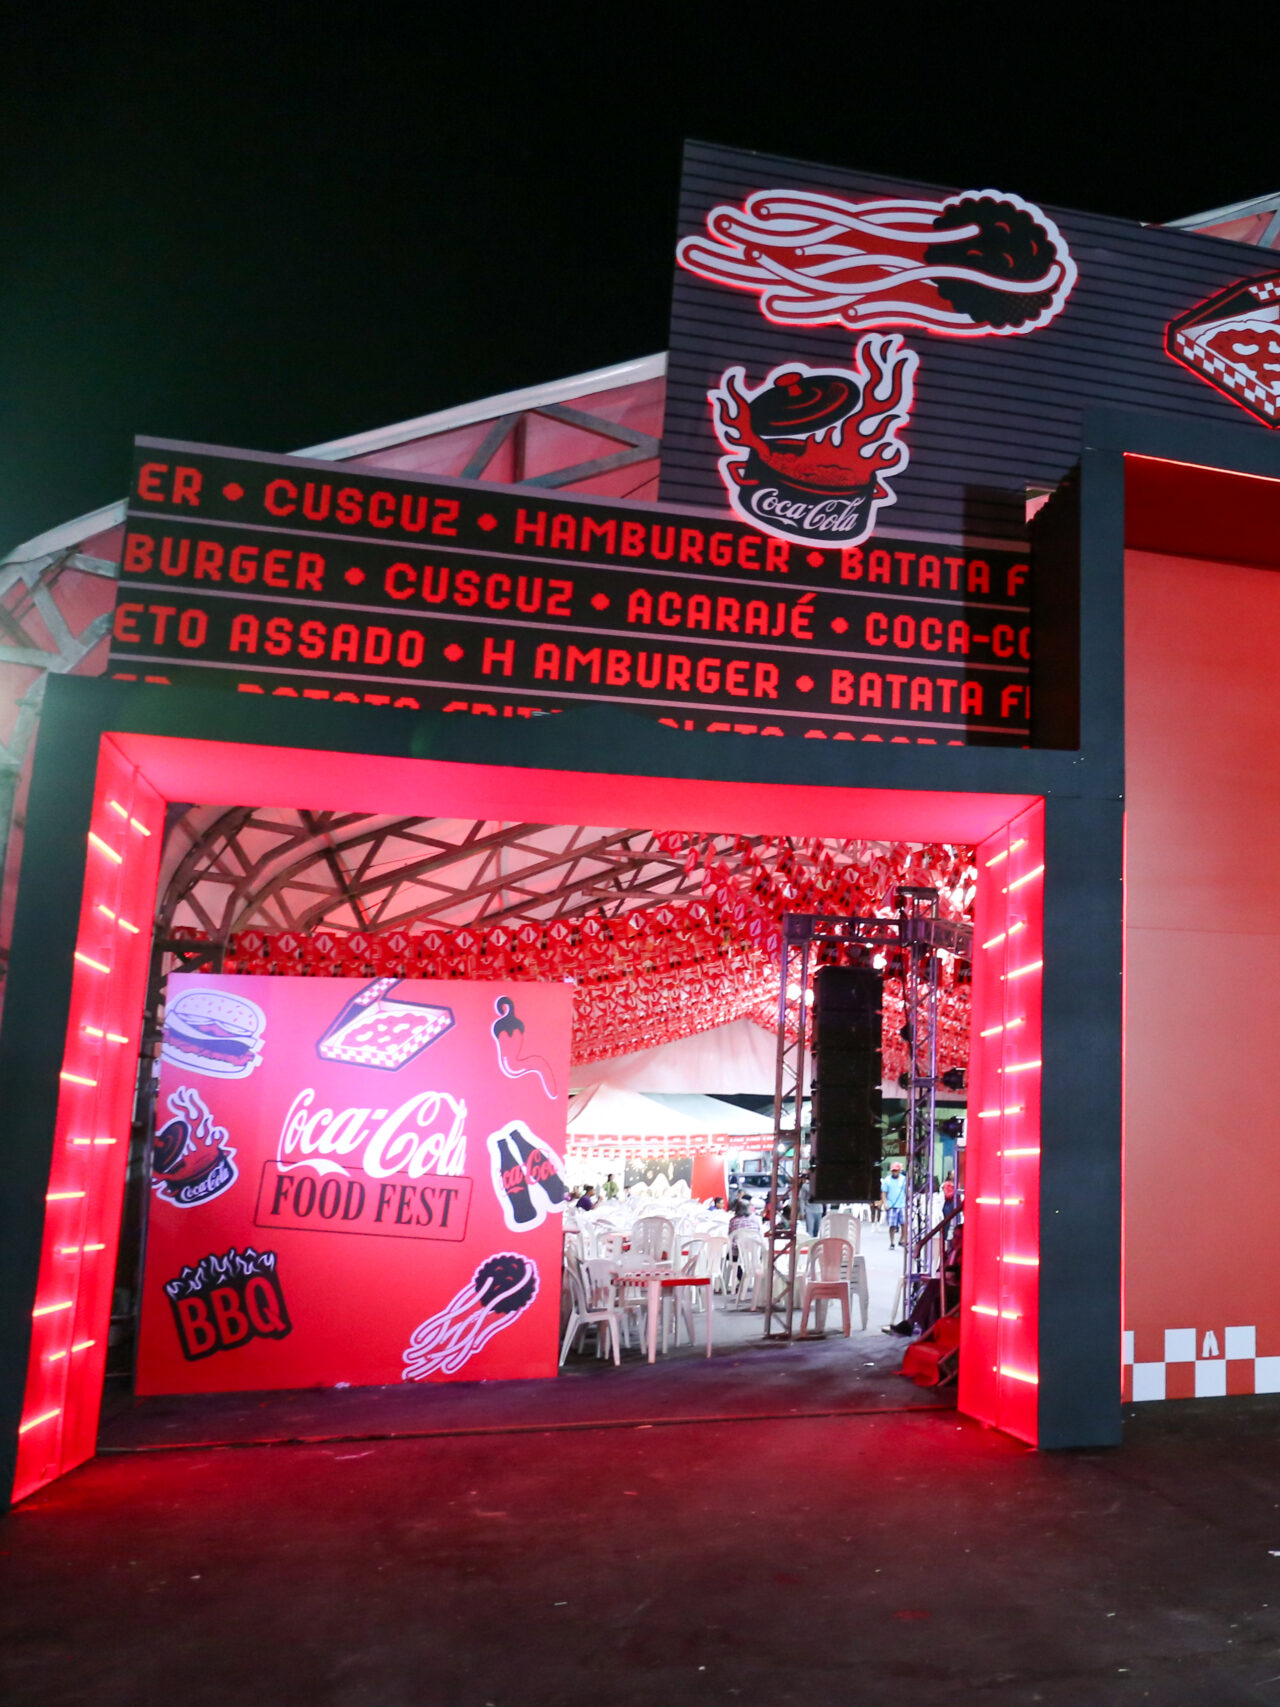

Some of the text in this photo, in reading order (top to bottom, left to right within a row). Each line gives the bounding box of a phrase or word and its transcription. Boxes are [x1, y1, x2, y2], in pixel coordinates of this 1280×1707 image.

[137, 463, 203, 506] ER
[264, 478, 460, 537] CUSCUZ
[514, 507, 790, 575] HAMBURGER
[840, 548, 990, 594] BATATA
[751, 487, 866, 532] Coca-Cola
[123, 532, 326, 592] BURGER
[384, 561, 574, 617] CUSCUZ
[627, 588, 817, 640] ACARAJÉ
[112, 603, 209, 650] ETO
[229, 613, 425, 668] ASSADO
[830, 668, 983, 717] BATATA
[1001, 684, 1031, 720] F
[276, 1088, 468, 1179] Coca-Cola
[270, 1175, 459, 1228] FOOD FEST
[178, 1277, 286, 1357] BBQ
